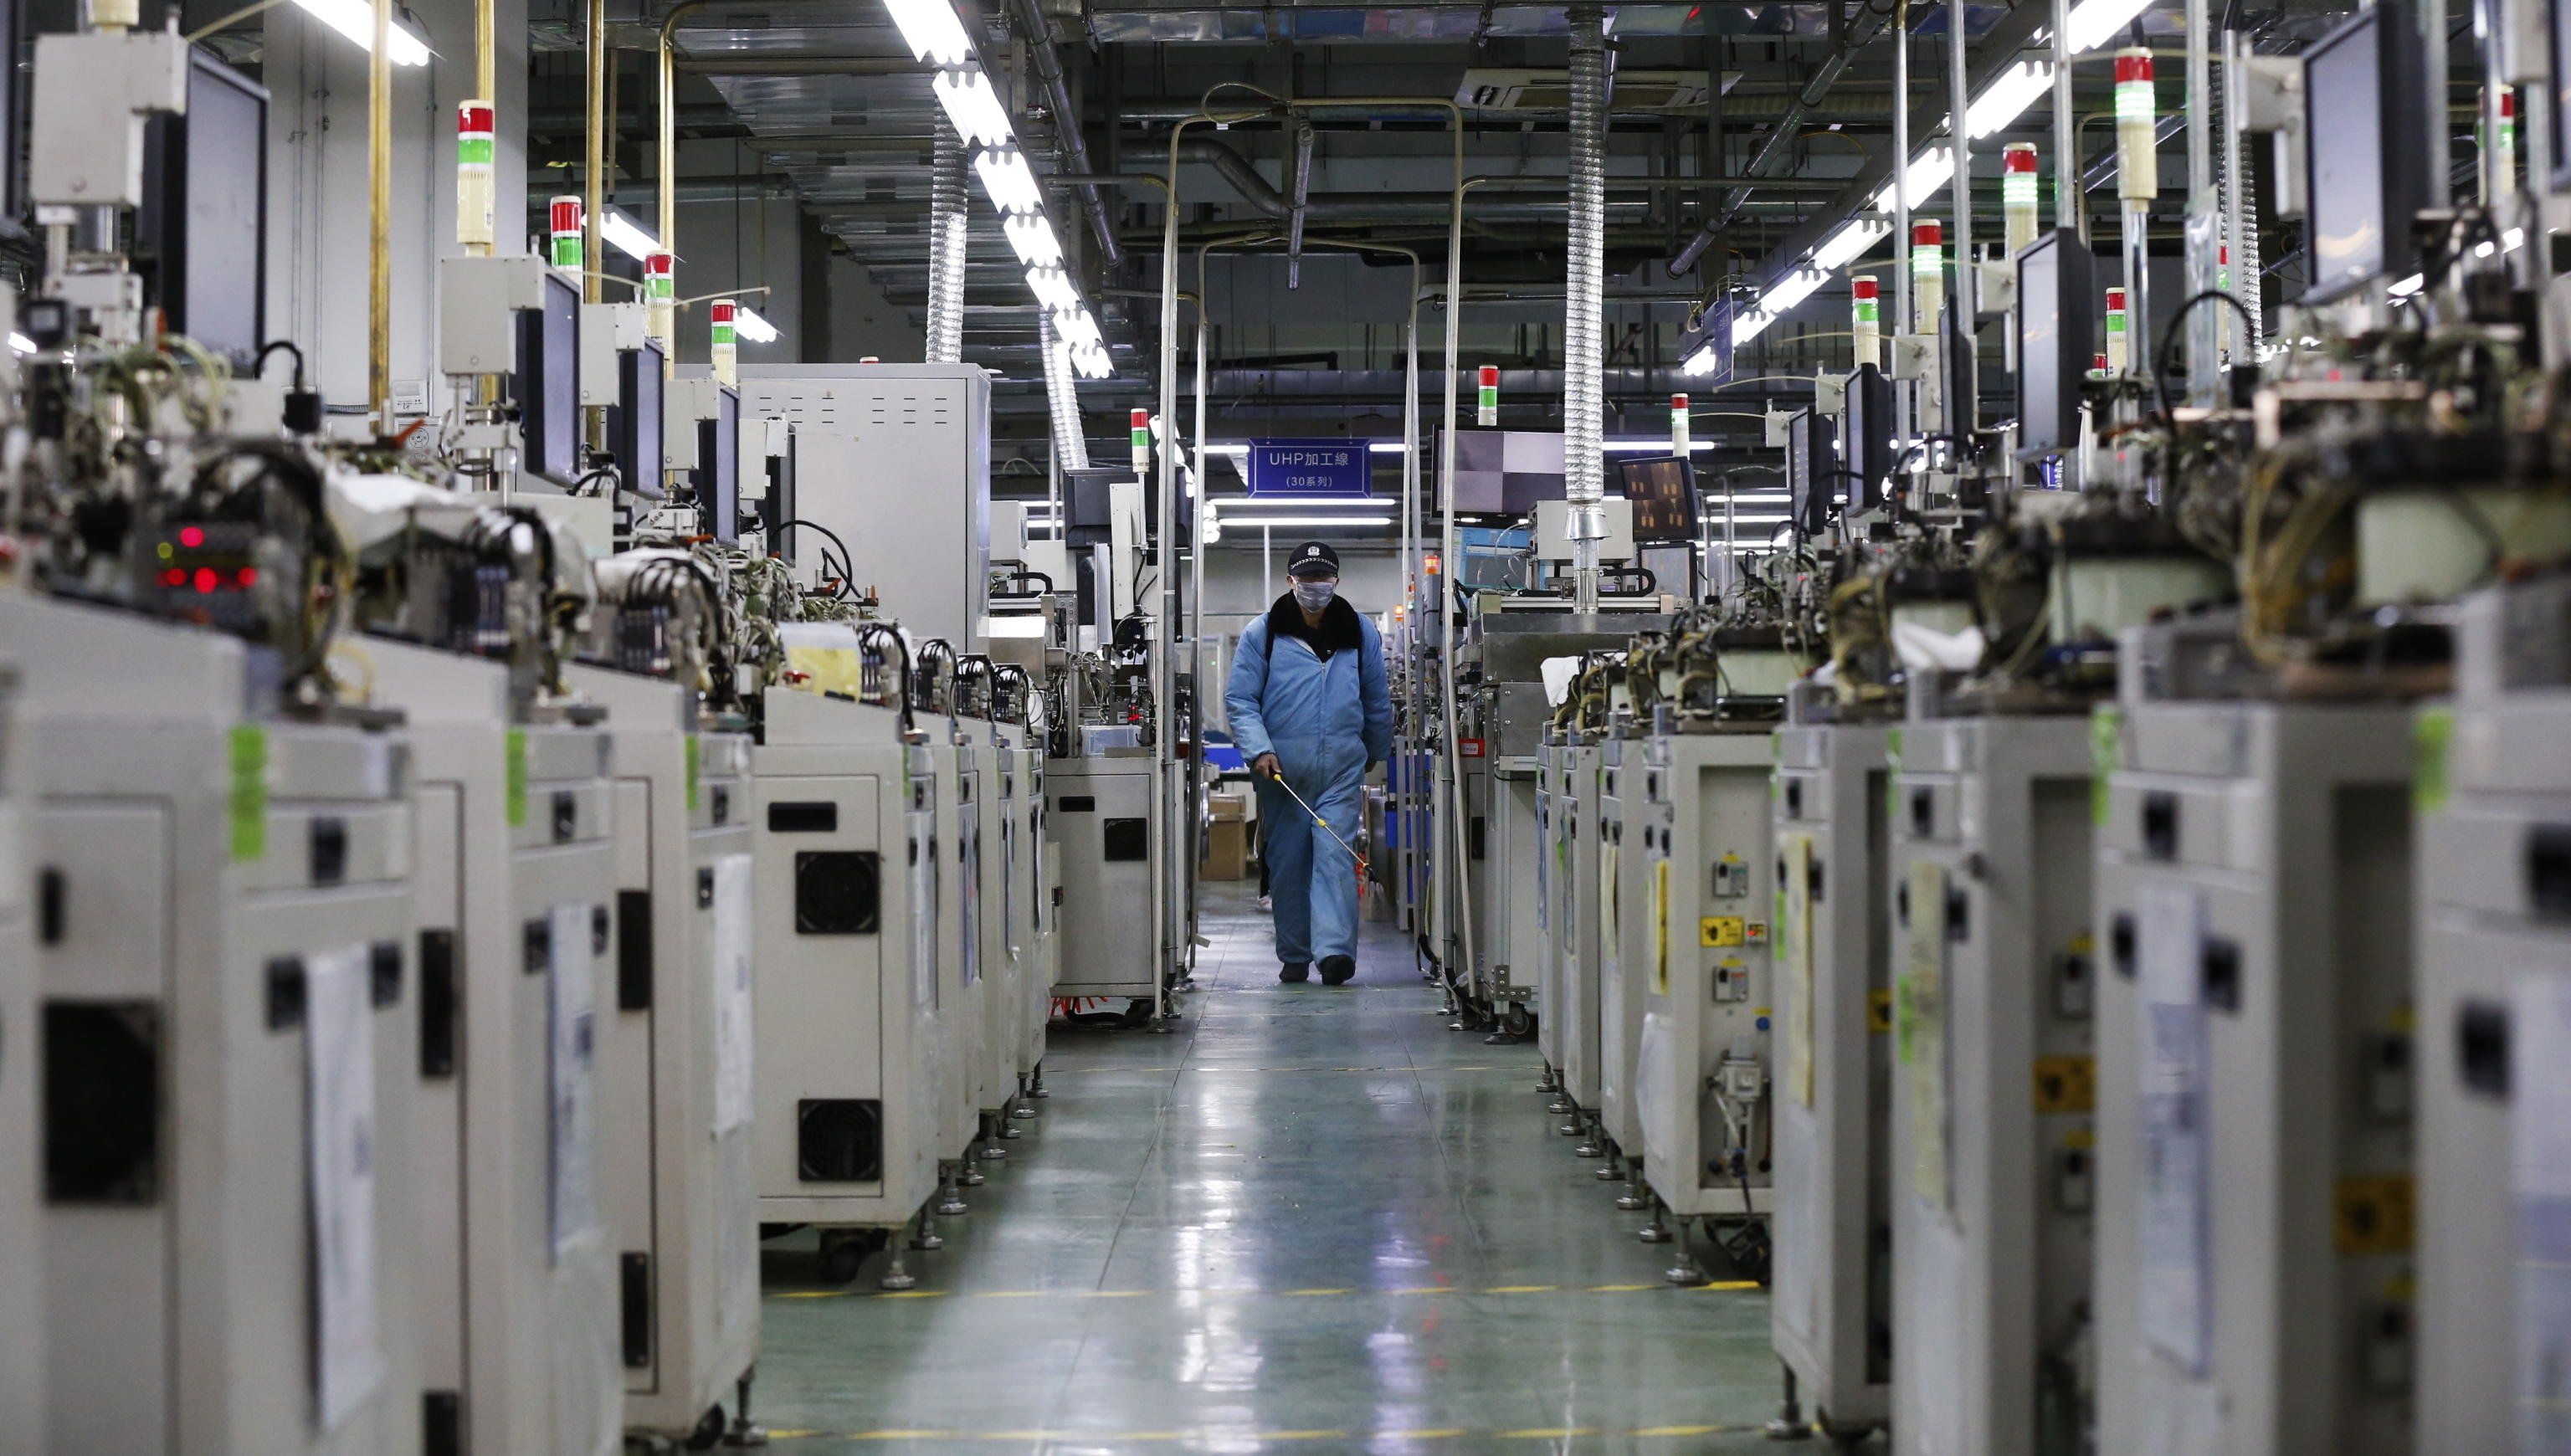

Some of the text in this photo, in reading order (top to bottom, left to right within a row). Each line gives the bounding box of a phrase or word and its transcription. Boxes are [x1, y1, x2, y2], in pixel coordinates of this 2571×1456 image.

[1270, 452, 1348, 466] UHP加工線
[1286, 476, 1332, 488] (30系列)
